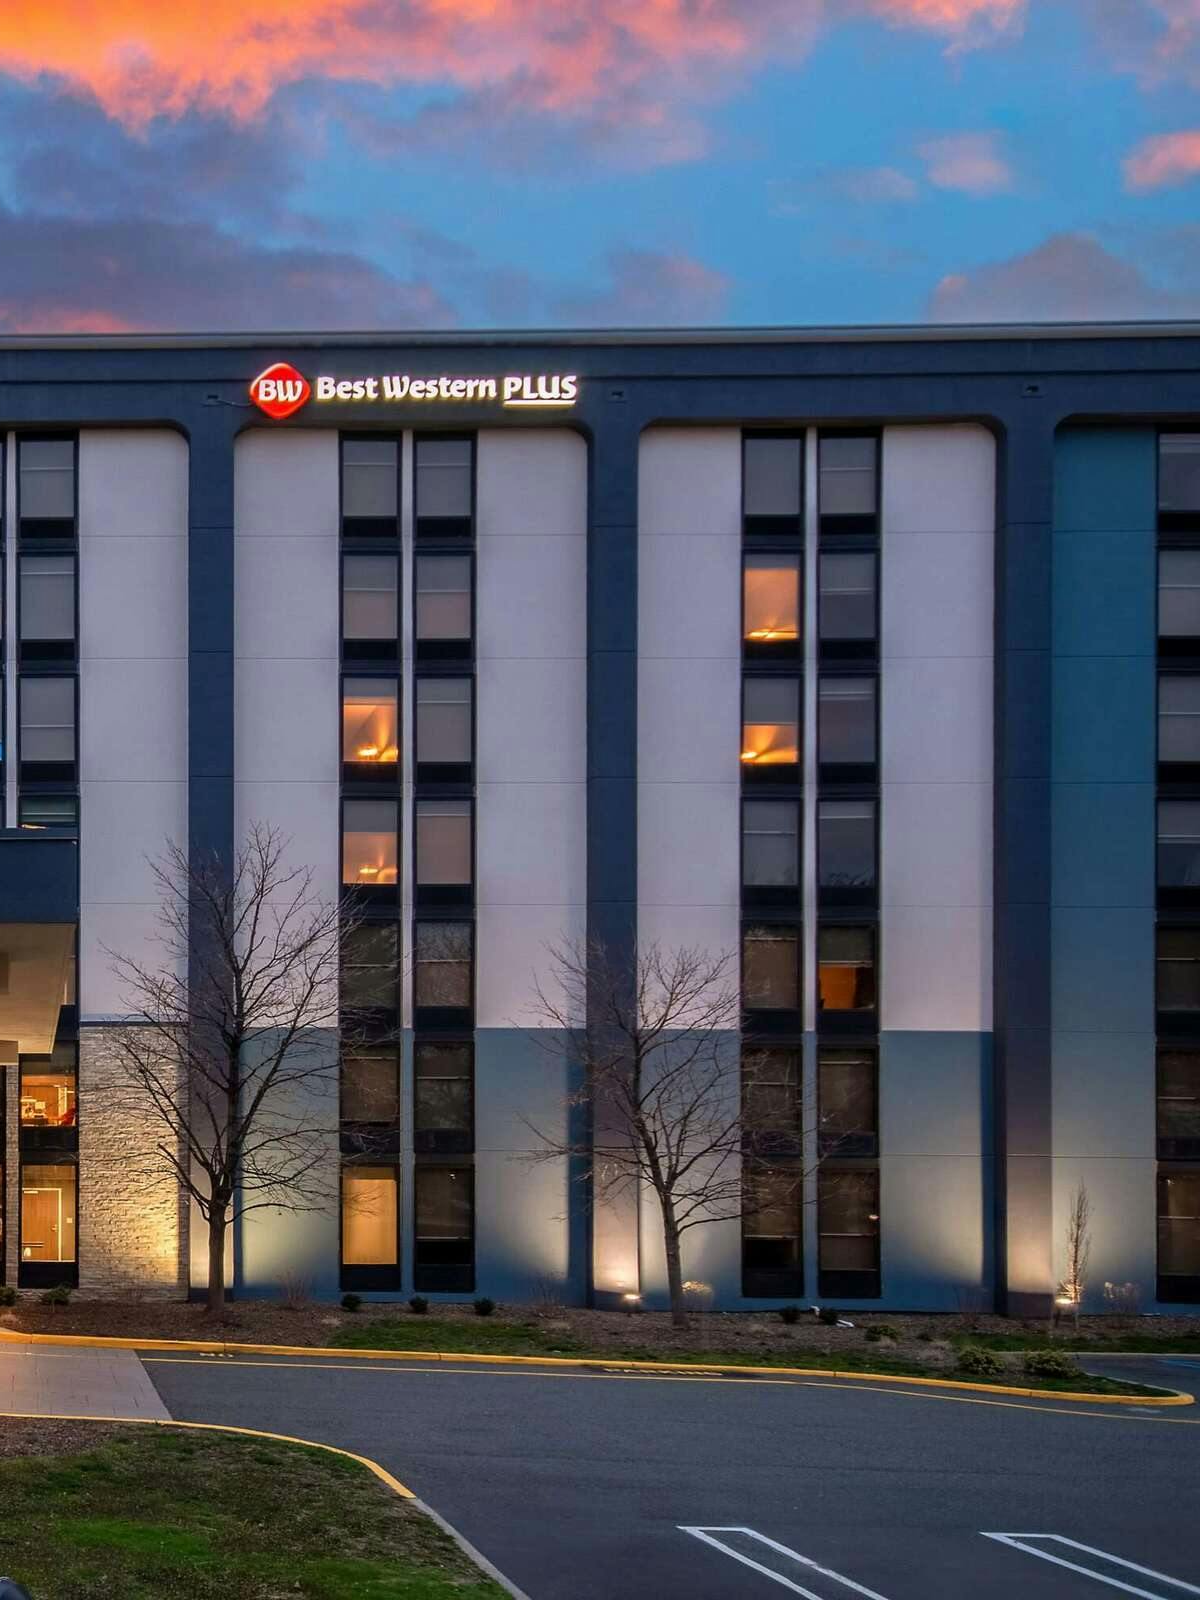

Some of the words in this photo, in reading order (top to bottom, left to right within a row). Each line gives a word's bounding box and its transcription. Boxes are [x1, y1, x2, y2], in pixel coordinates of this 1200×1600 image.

[258, 379, 303, 402] BW
[317, 376, 379, 399] Best
[382, 375, 497, 399] Western
[503, 375, 577, 400] PLUS
